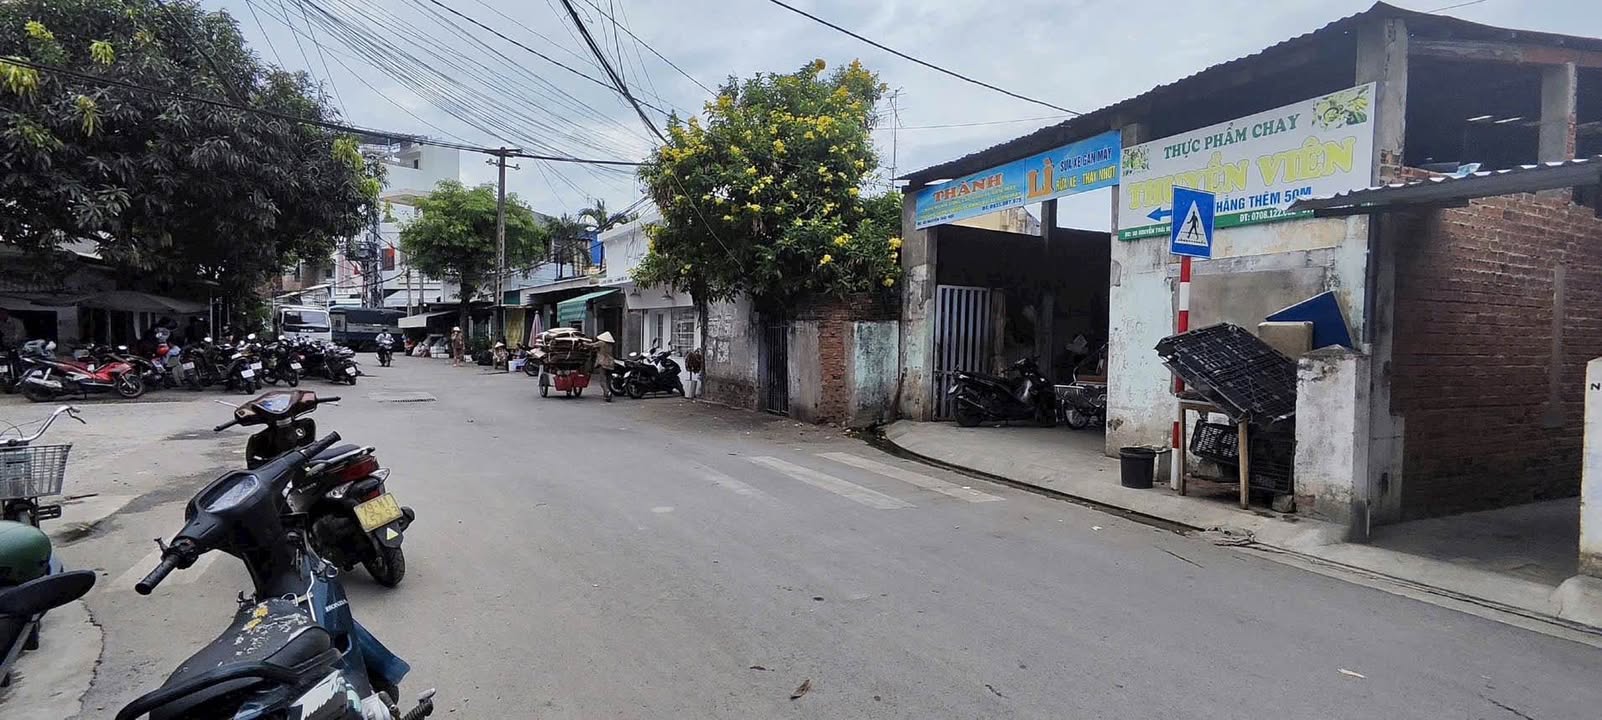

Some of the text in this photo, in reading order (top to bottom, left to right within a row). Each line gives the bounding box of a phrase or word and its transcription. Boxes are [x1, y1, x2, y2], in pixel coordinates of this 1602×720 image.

[1163, 113, 1300, 159] THỰC PHẨM CHAY
[1249, 191, 1280, 208] THÊM
